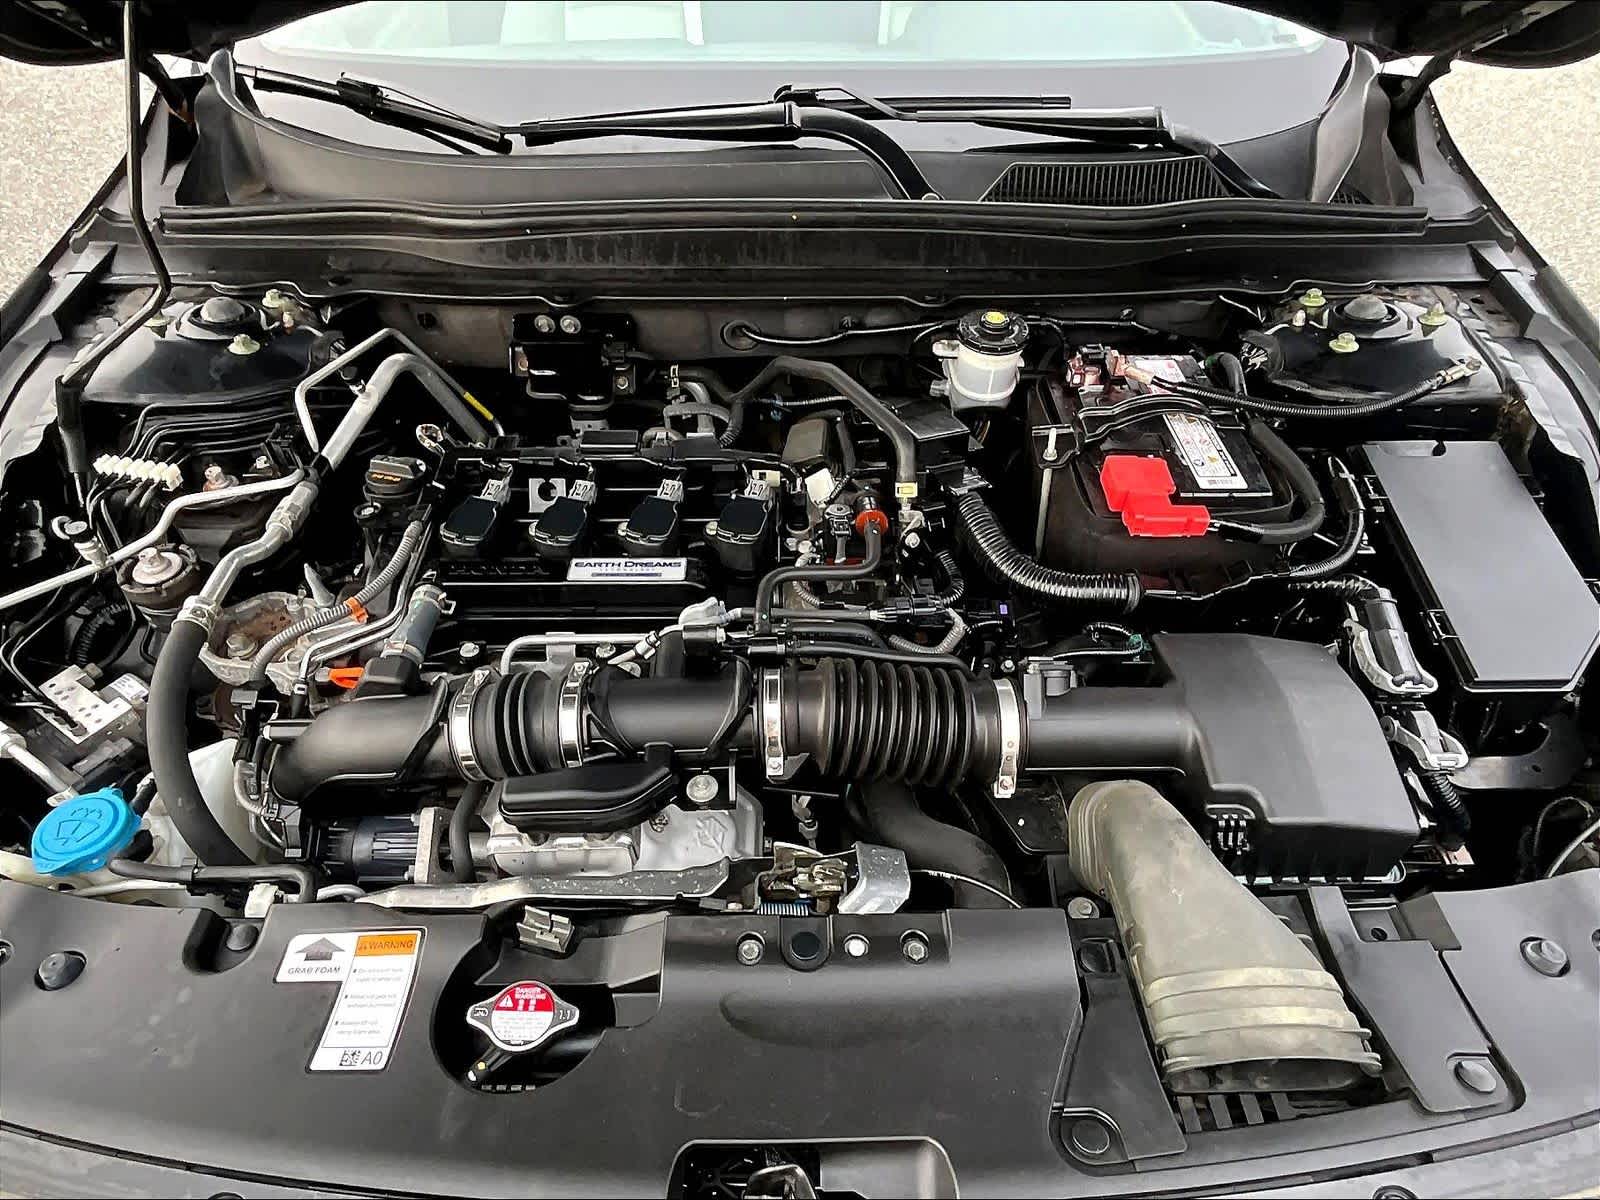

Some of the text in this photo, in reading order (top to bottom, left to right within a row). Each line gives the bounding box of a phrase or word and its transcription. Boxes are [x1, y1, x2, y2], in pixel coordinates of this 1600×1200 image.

[624, 560, 682, 568] DREAMS
[367, 940, 413, 950] WARNING
[287, 966, 341, 975] GRAB FOAM
[361, 1050, 383, 1065] A0
